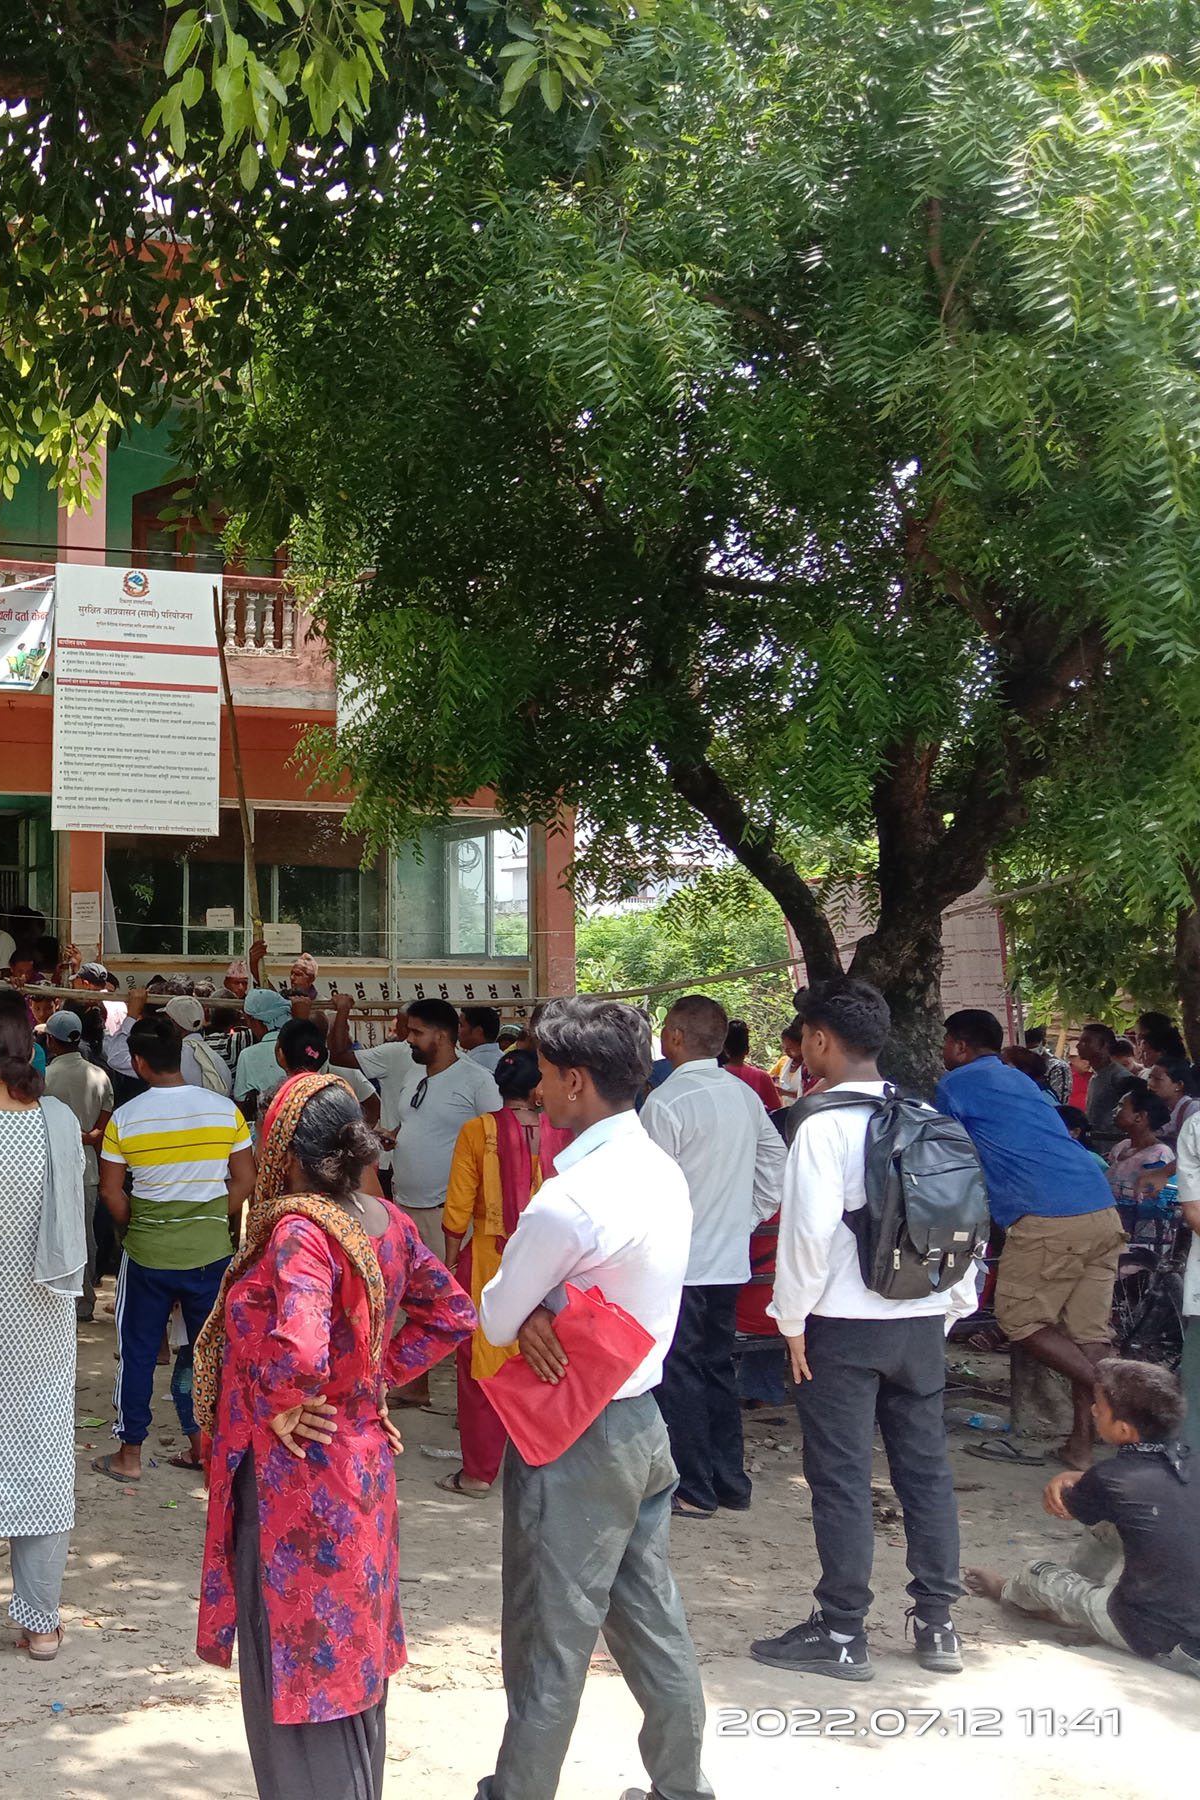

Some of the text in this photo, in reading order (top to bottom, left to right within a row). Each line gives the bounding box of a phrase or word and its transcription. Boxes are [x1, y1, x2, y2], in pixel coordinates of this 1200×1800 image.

[15, 610, 29, 622] दर्ता
[78, 604, 193, 621] सुरक्षित आप्रवासन (सामी) परियोजना
